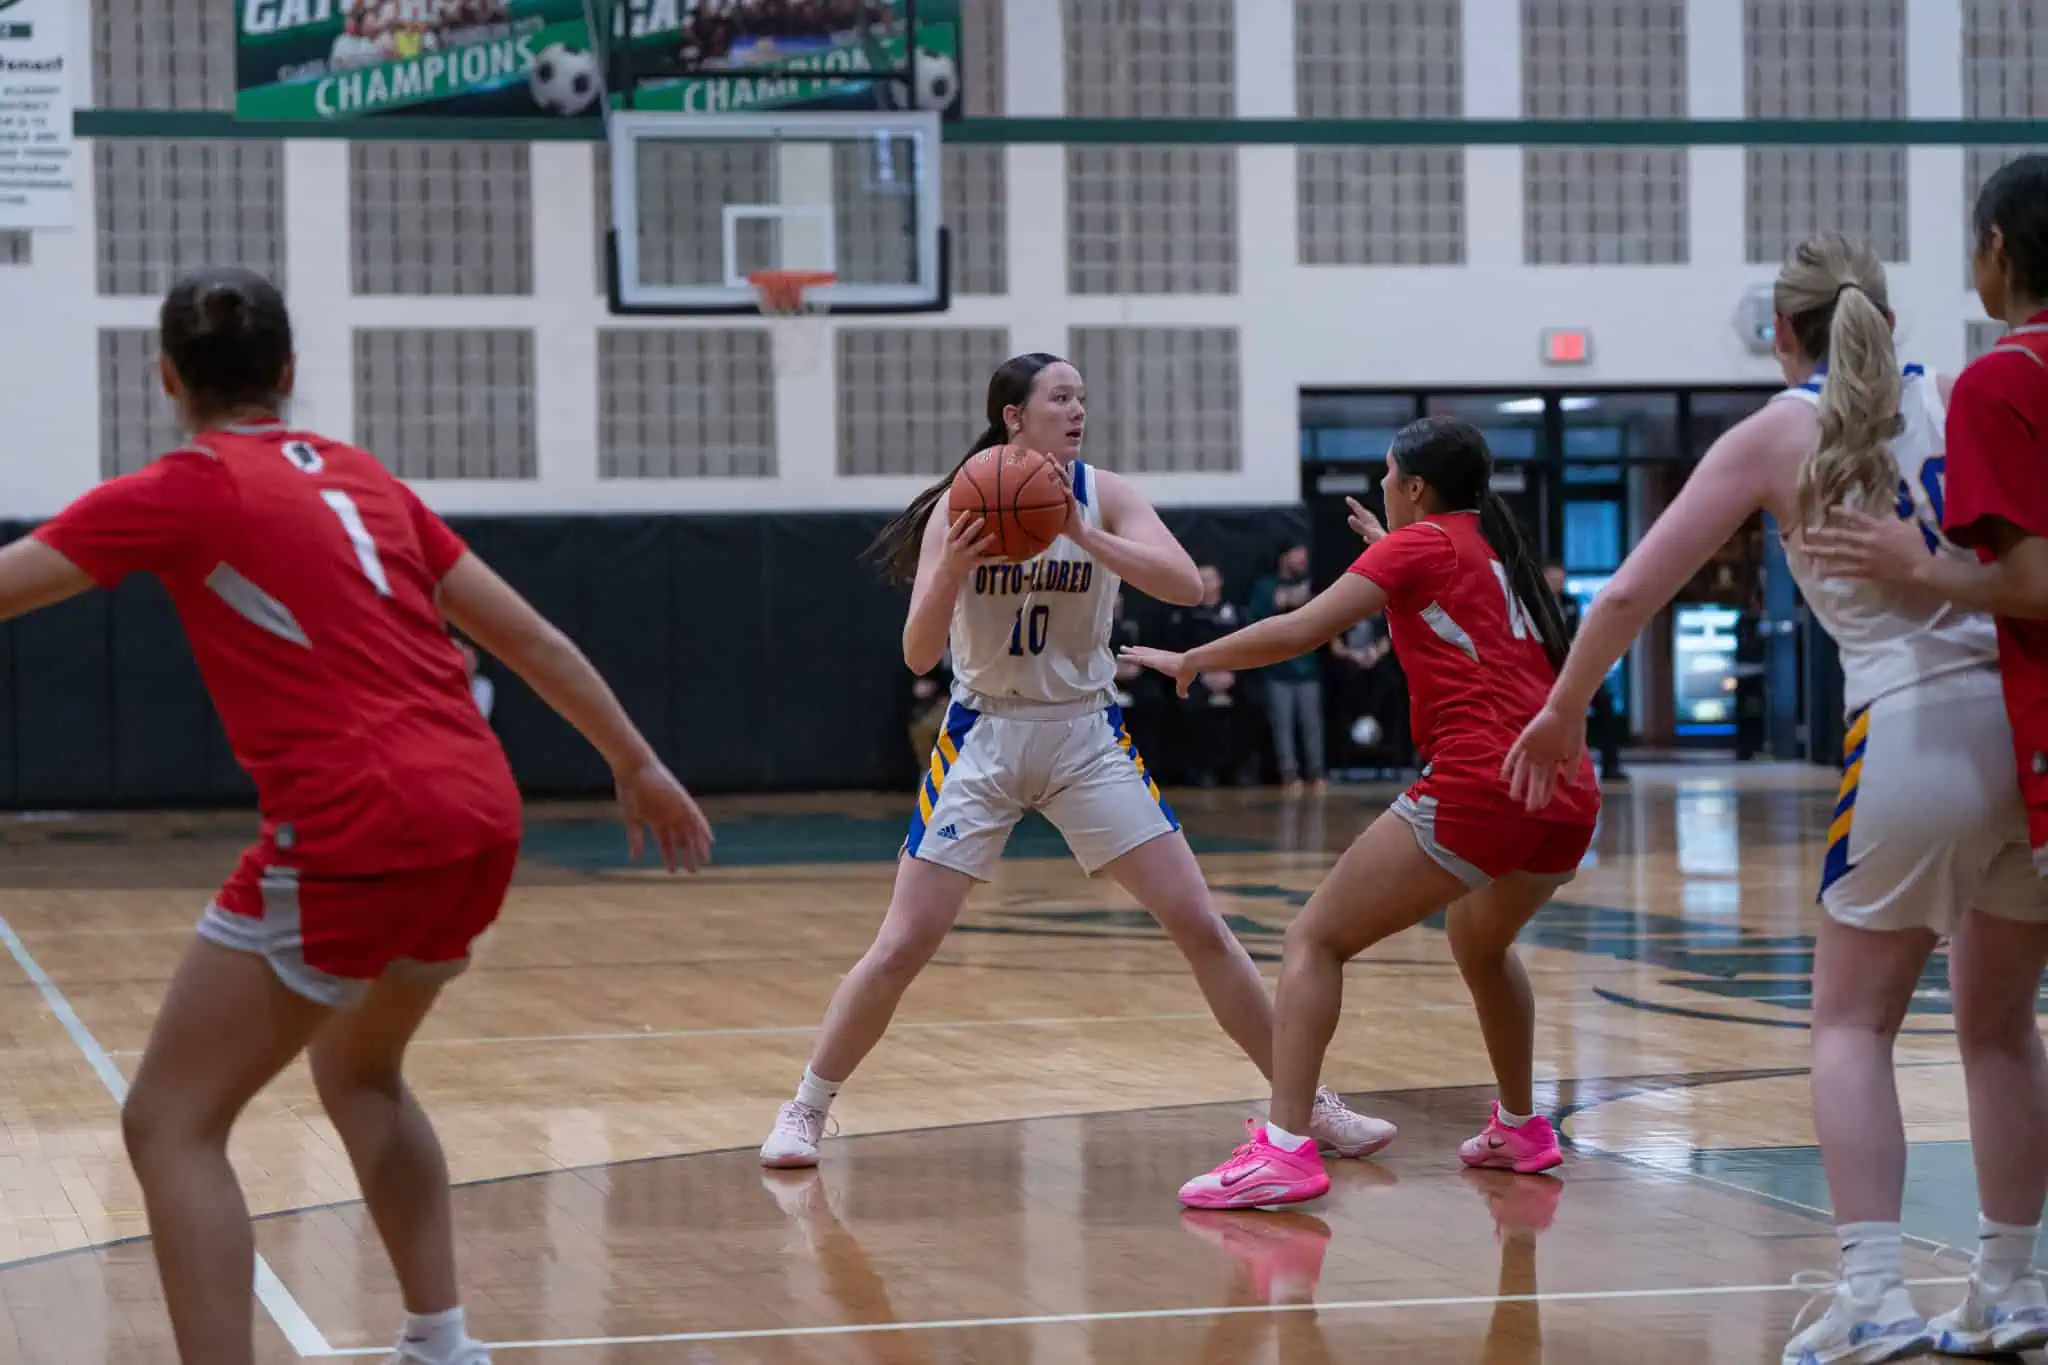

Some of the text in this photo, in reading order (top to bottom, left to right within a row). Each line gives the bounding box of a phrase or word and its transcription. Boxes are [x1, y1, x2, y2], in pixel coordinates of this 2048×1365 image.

[314, 35, 535, 117] CHAMPIONS
[319, 489, 393, 597] 1
[1008, 604, 1049, 656] 10
